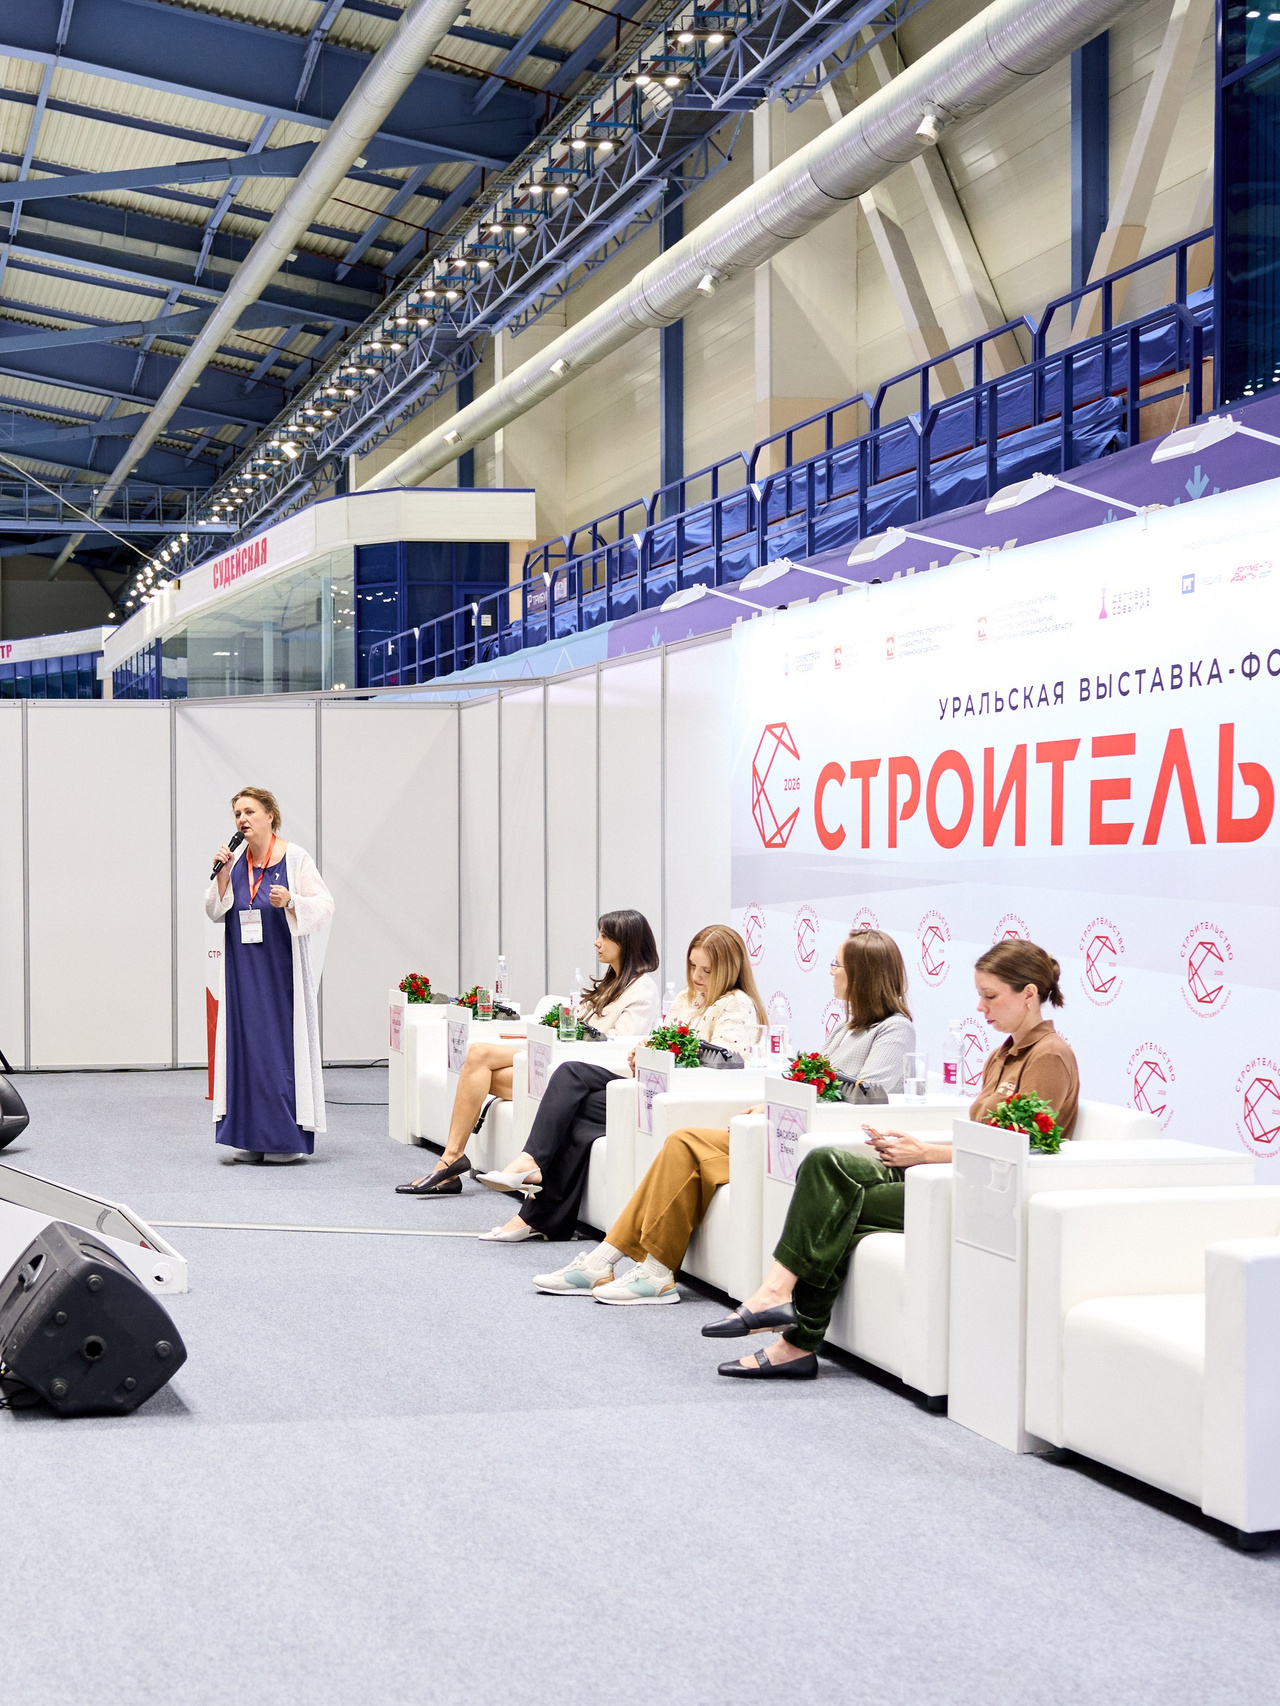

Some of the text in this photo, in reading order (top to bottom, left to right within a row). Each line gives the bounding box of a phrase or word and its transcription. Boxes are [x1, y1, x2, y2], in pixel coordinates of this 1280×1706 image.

[213, 537, 267, 589] СУДЕЙСКАЯ
[939, 681, 1065, 721] УРАЛЬСКАЯ
[784, 777, 800, 791] 2026
[814, 722, 1275, 851] СТРОИТЕЛЬ
[208, 950, 222, 959] СТР
[1079, 917, 1125, 953] СТРОИТЕЛЬСТВО
[1180, 921, 1234, 960] СТРОИТЕЛЬСТВО
[1126, 1042, 1176, 1082] СТРОИТЕЛЬСТВО
